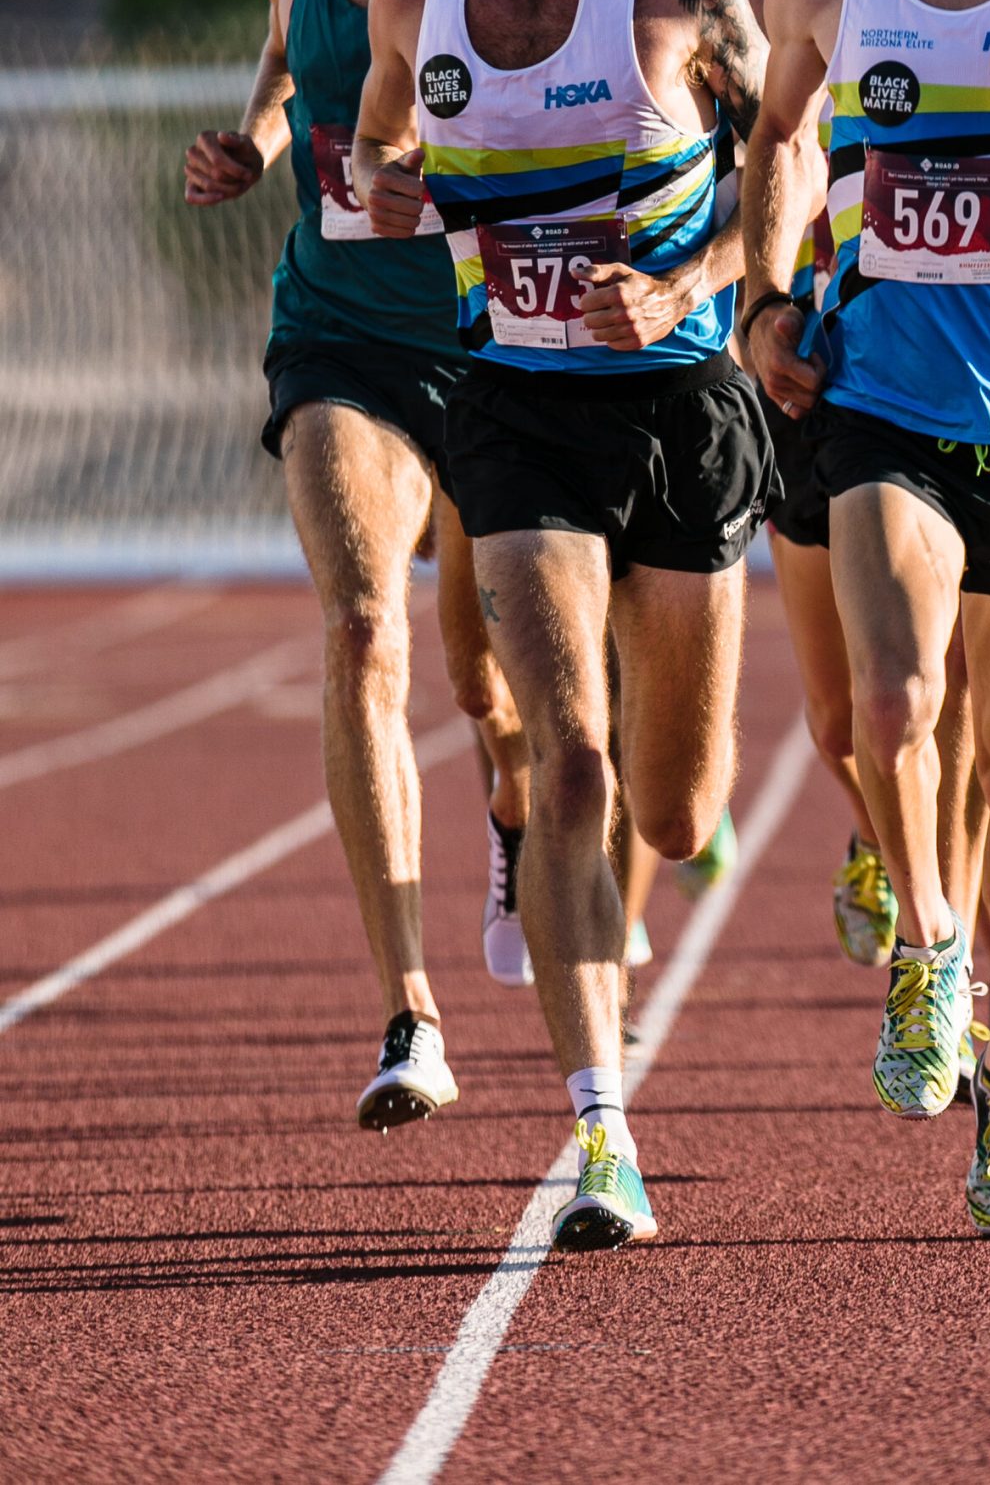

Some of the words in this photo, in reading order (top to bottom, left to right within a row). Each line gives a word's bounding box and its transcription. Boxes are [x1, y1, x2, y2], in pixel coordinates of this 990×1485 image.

[861, 29, 919, 40] NORTHERN
[860, 38, 902, 48] ARIZONA
[906, 39, 934, 49] ELITE
[425, 69, 461, 82] BLACK
[870, 75, 909, 89] BLACK
[428, 80, 459, 93] LIVES
[870, 86, 905, 100] LIVES
[424, 90, 467, 104] MATTER
[544, 79, 612, 110] HOKA
[863, 96, 912, 113] MATTER
[893, 188, 981, 248] 569
